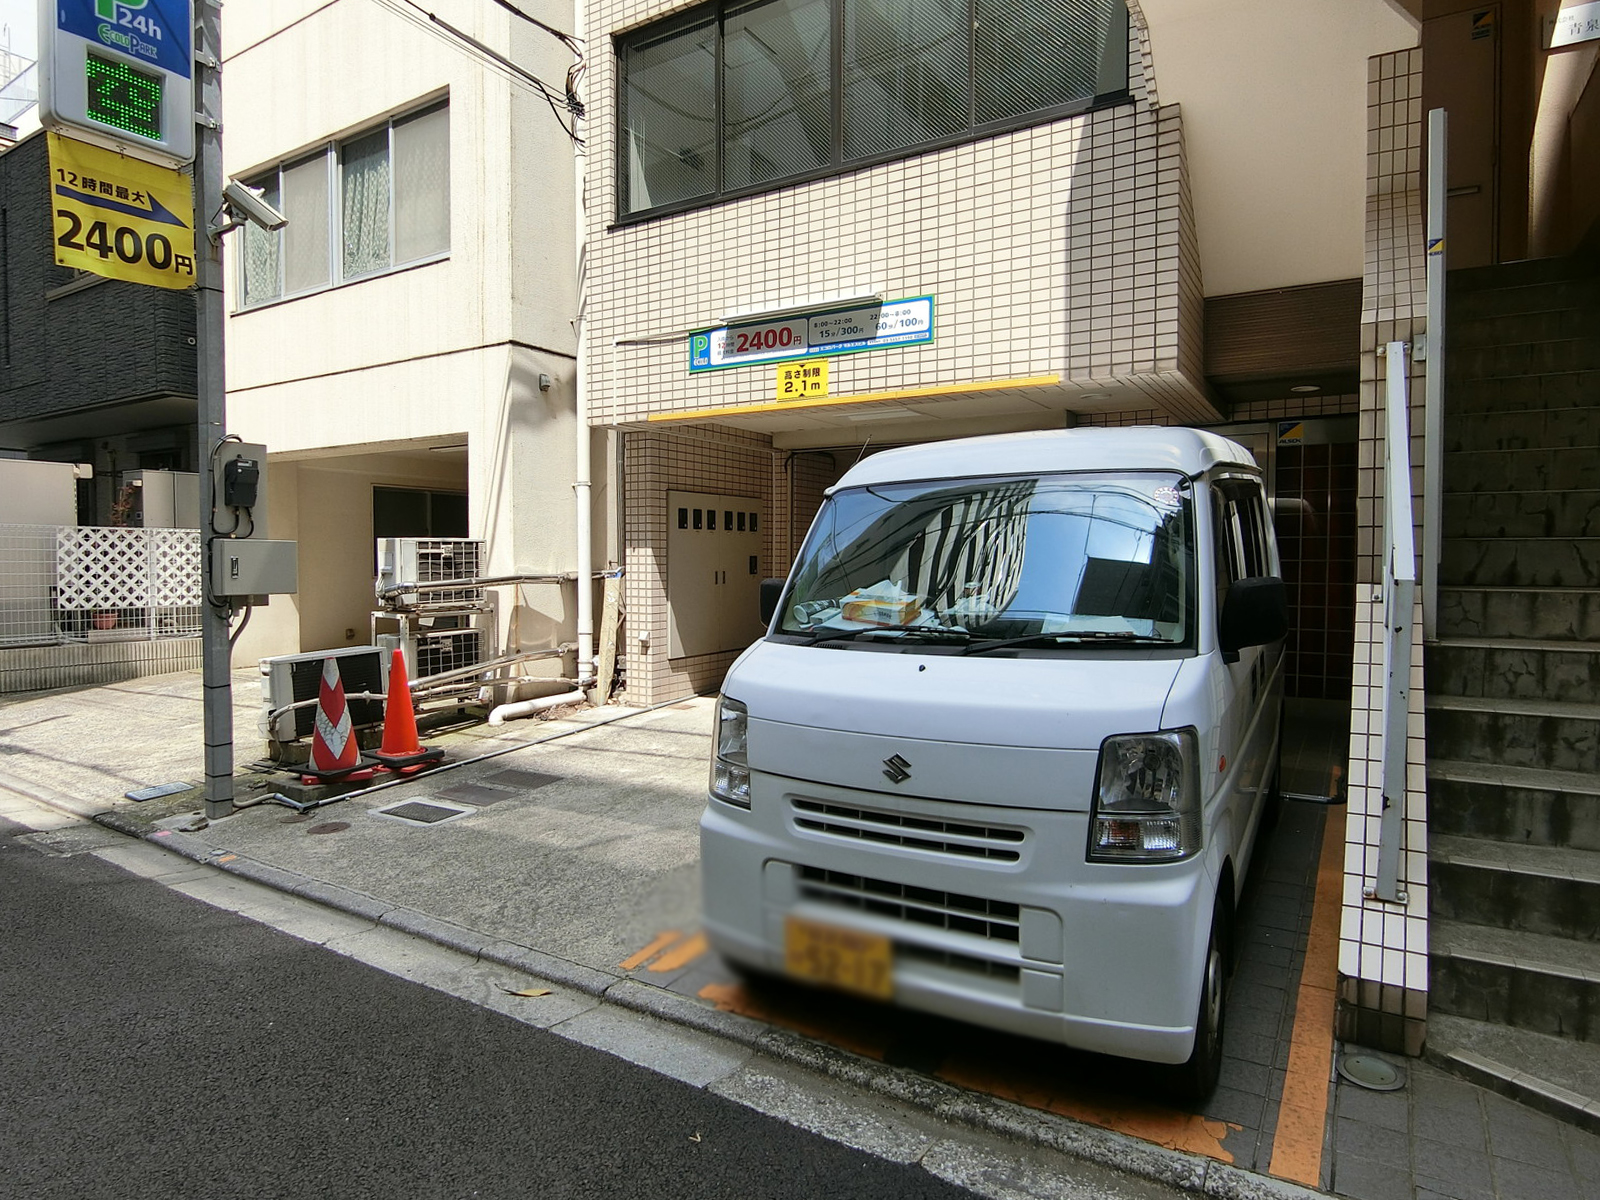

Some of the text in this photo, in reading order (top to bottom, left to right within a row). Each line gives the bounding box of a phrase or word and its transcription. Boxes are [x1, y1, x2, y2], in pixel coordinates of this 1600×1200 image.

[118, 7, 162, 41] 24h
[56, 167, 146, 206] 12時間最大
[57, 208, 193, 276] 2400円
[693, 335, 708, 358] P
[736, 327, 802, 353] 2400円
[784, 366, 822, 381] 高さ制限
[784, 379, 822, 394] 2.1m
